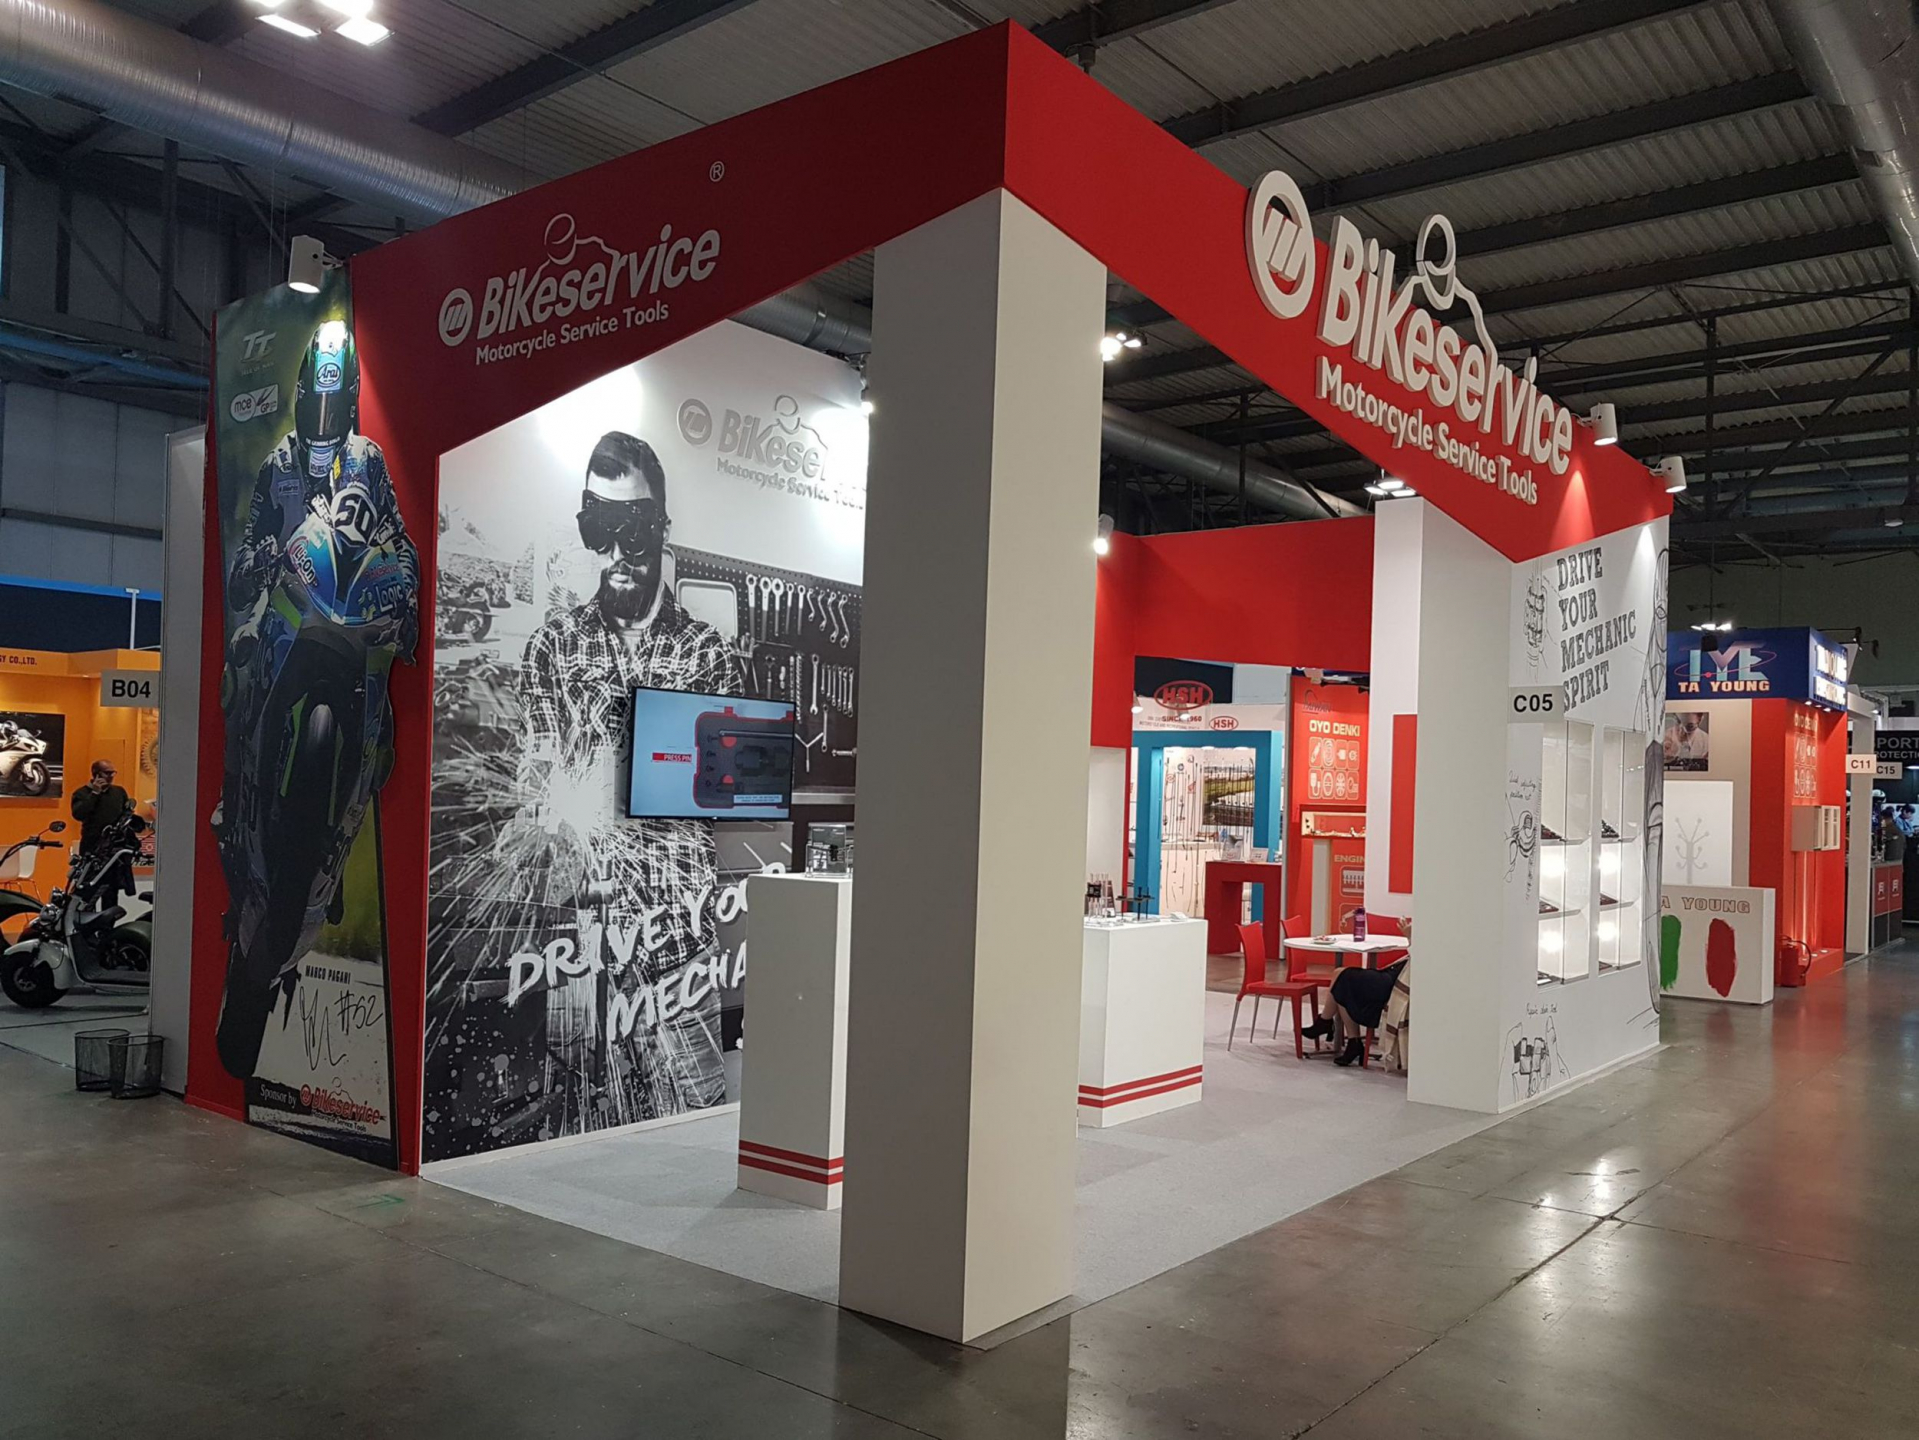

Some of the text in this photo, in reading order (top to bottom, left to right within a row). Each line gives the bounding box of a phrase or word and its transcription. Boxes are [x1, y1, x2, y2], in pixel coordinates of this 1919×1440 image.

[477, 224, 721, 340] Bikeservice
[476, 301, 670, 365] Motorcycle Service Tools
[1317, 216, 1574, 475] Bikeservice
[1316, 356, 1538, 505] Motorcycle Service Tools
[1557, 547, 1602, 591] DRIVE
[1558, 588, 1598, 631] YOUR
[1561, 609, 1637, 673] MECHANIC
[111, 679, 151, 698] B04
[1162, 687, 1204, 704] HSH
[1563, 660, 1609, 713] SPIRIT
[1678, 680, 1770, 693] TA YOUNG
[1513, 693, 1553, 713] C05
[1213, 718, 1235, 729] HSH
[1309, 720, 1361, 737] OYO DENKI
[1851, 759, 1871, 770] C11
[1876, 765, 1896, 775] C15
[1681, 897, 1751, 914] YOUNG
[502, 905, 673, 1008] DRIVE
[260, 1083, 297, 1108] Sponsor by
[312, 1087, 380, 1125] Bikeservice
